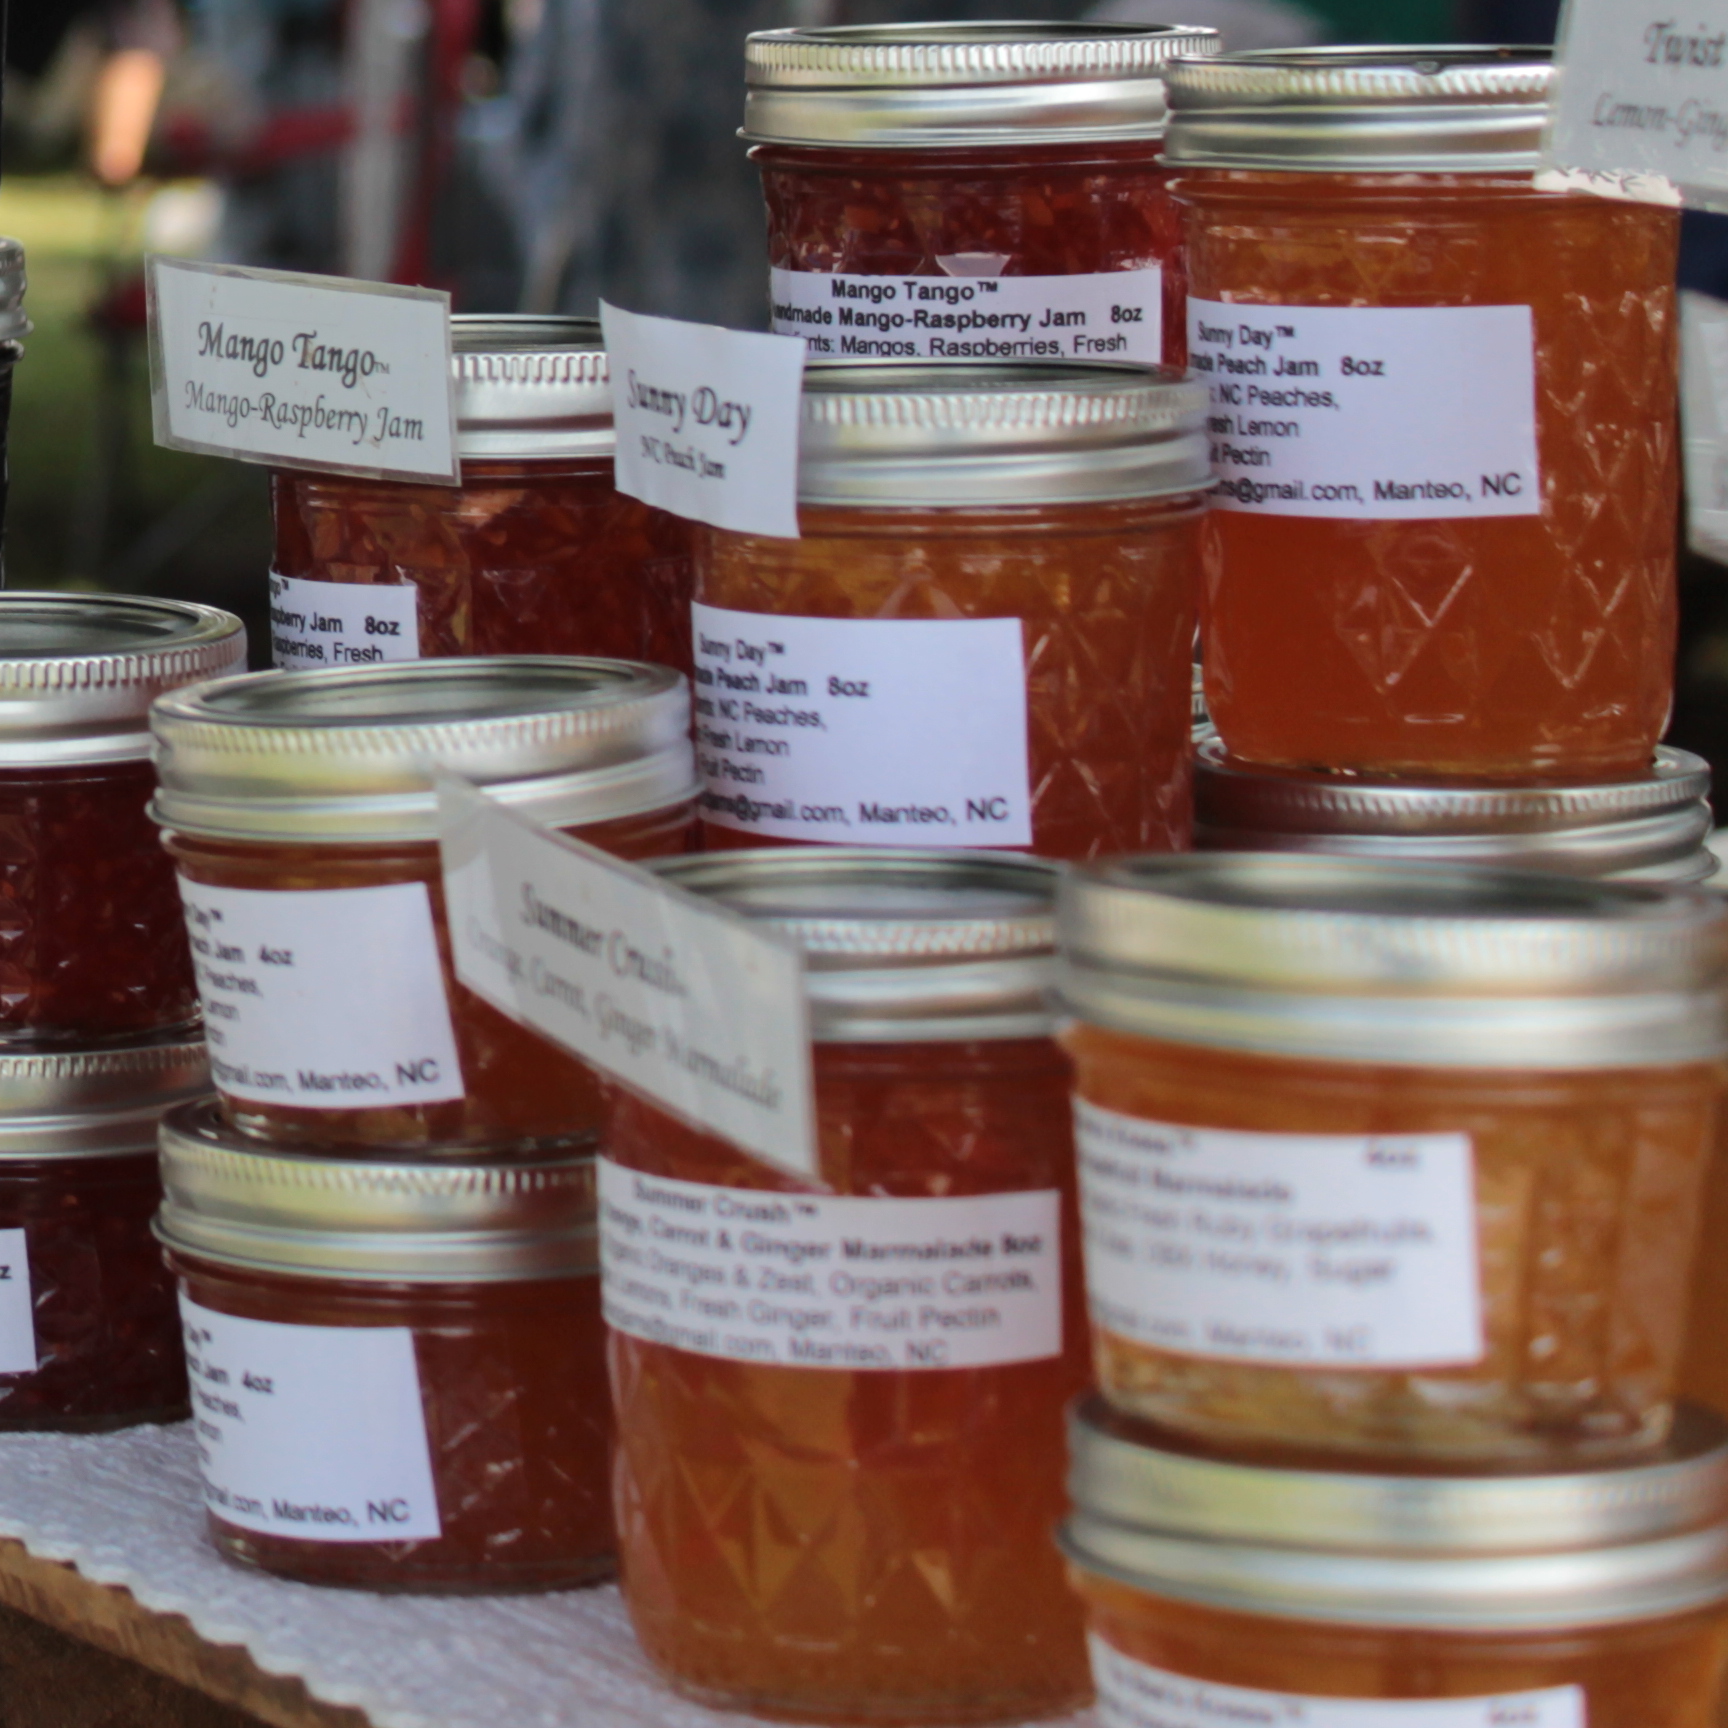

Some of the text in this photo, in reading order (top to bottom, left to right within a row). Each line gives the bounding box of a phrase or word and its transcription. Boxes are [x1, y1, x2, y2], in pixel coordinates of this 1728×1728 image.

[1644, 20, 1726, 66] Twist
[831, 280, 896, 303] Mango
[838, 306, 1142, 332] Mango-Raspberry Jam 8oz
[930, 334, 1126, 357] Raspberries, Fresh
[1198, 322, 1234, 348] Sunny
[199, 321, 285, 376] Mango
[1217, 353, 1384, 377] Peach Jam 8oz
[626, 368, 752, 445] Sunny Day
[1220, 384, 1340, 410] NC Peaches,
[185, 381, 424, 444] Mango-Raspberry Jam
[1238, 416, 1299, 437] Lemon
[640, 434, 726, 479] NC Peach Jam
[1222, 445, 1271, 466] Pectin
[1374, 474, 1522, 501] Manteo, NC
[310, 612, 400, 635] Jam 8oz
[334, 642, 383, 662] Fresh
[766, 674, 807, 696] Jam
[827, 677, 870, 697] 8oz
[744, 703, 828, 731] Peaches,
[736, 733, 790, 756] Lemon
[859, 797, 1009, 825] Manteo, NC
[521, 881, 604, 954] Summer
[215, 942, 293, 966] Jam 4oz
[297, 1059, 440, 1092] Manteo, NC
[718, 1229, 992, 1262] & Ginger Marmalade
[829, 1270, 934, 1299] Organic
[850, 1303, 1000, 1327] Fruit Pectin
[905, 1340, 949, 1364] NC
[242, 1370, 274, 1394] 4oz
[367, 1498, 409, 1523] NC
